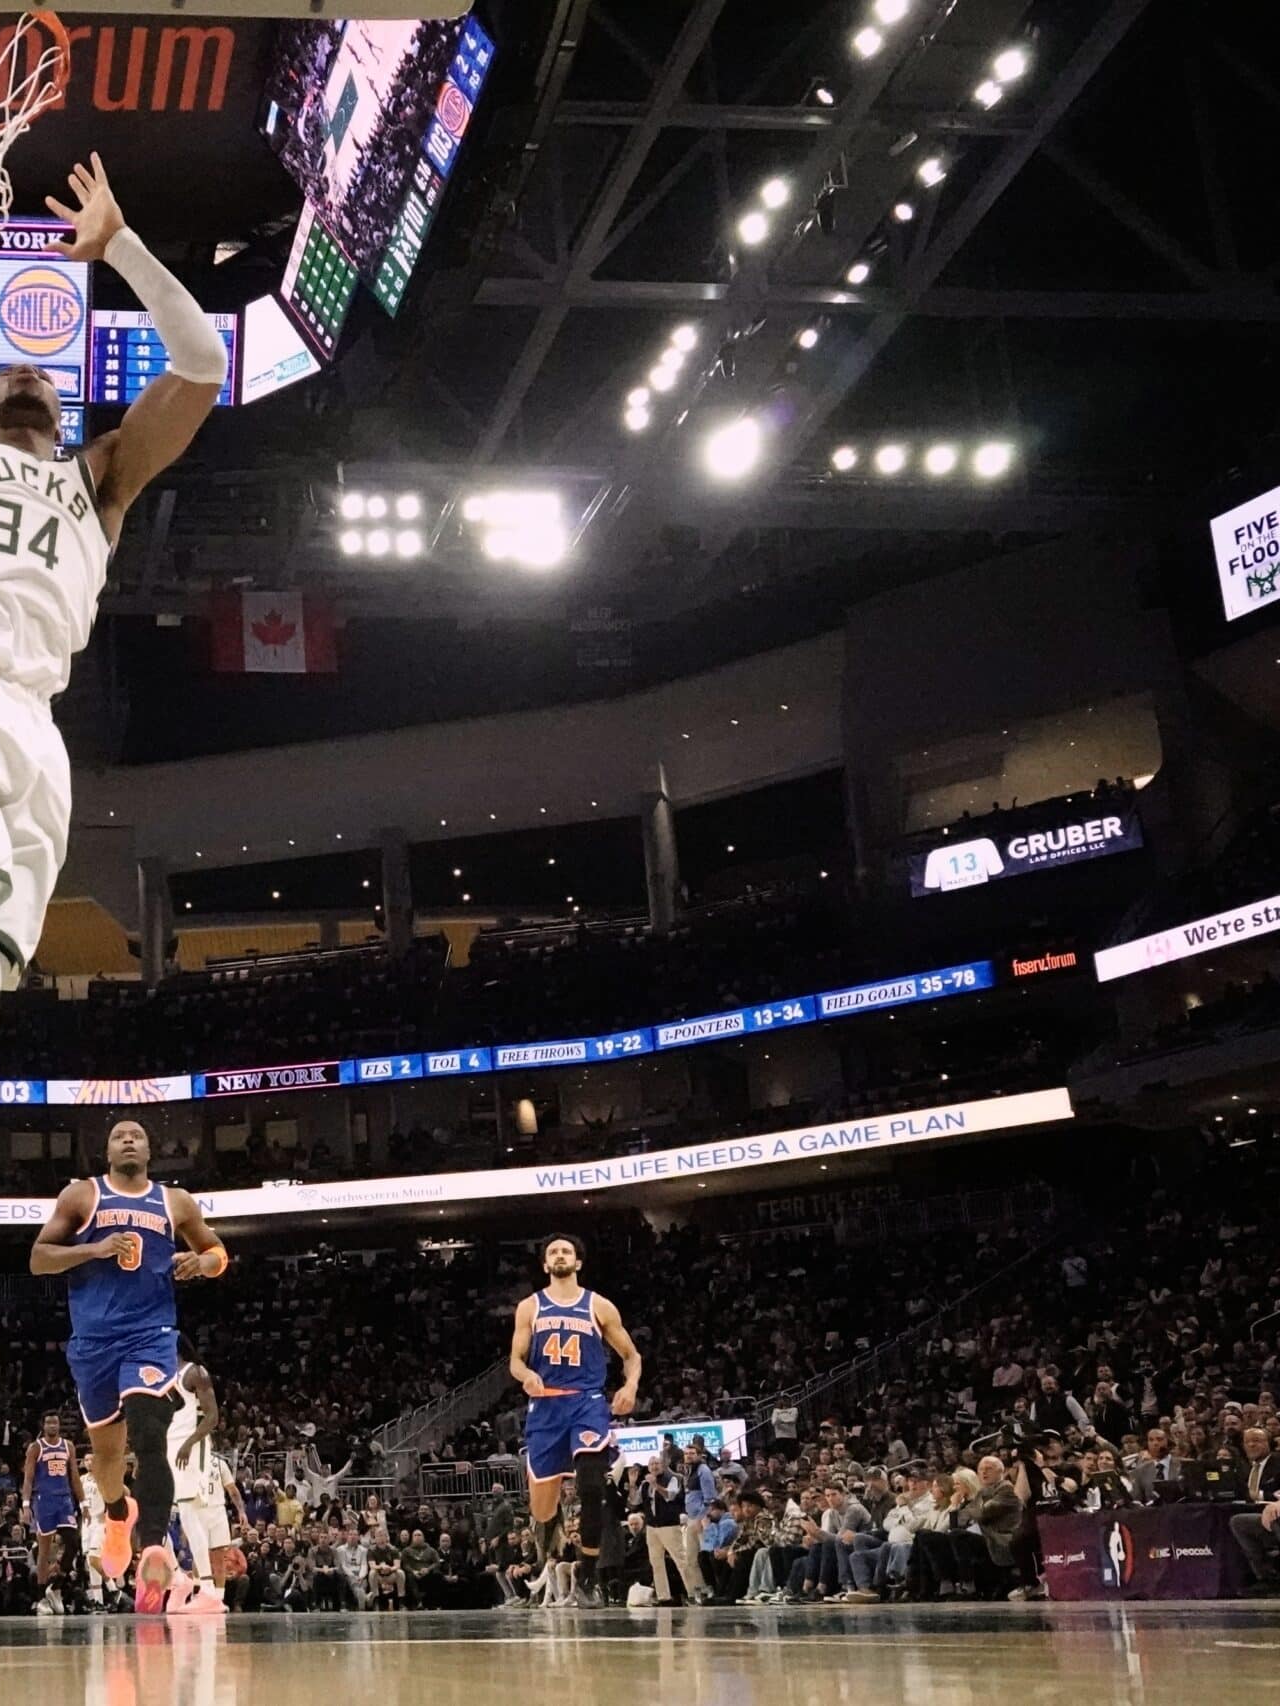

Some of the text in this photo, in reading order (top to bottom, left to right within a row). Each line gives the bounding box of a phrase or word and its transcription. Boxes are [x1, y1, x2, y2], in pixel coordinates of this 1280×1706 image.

[427, 122, 453, 167] 103
[405, 192, 428, 235] 101
[0, 231, 65, 249] YORK
[7, 291, 74, 332] KNICKS
[215, 315, 228, 328] FLS
[107, 344, 119, 355] 11
[1234, 510, 1280, 546] FIVE
[1240, 530, 1277, 553] ON THE
[1228, 540, 1280, 576] FLOO
[1008, 816, 1123, 859] GRUBER
[949, 852, 977, 875] 13
[1029, 842, 1106, 864] LAW OFFICES LLC
[1183, 918, 1245, 947] We're
[825, 969, 976, 1011] FIELD GOALS 35-78
[663, 1003, 804, 1043] 3-POINTERS 13-34
[431, 1053, 480, 1070] TOL 4
[501, 1035, 642, 1063] FREE THROWS 19-22
[217, 1067, 326, 1092] NEW YORK
[365, 1060, 410, 1076] FLS 2
[74, 1078, 168, 1104] KNICKS
[320, 1111, 966, 1206] Northwestern Mutual WHEN LIFE NEEDS A GAME PLAN
[96, 1208, 128, 1229] NEW
[542, 1332, 581, 1367] 44
